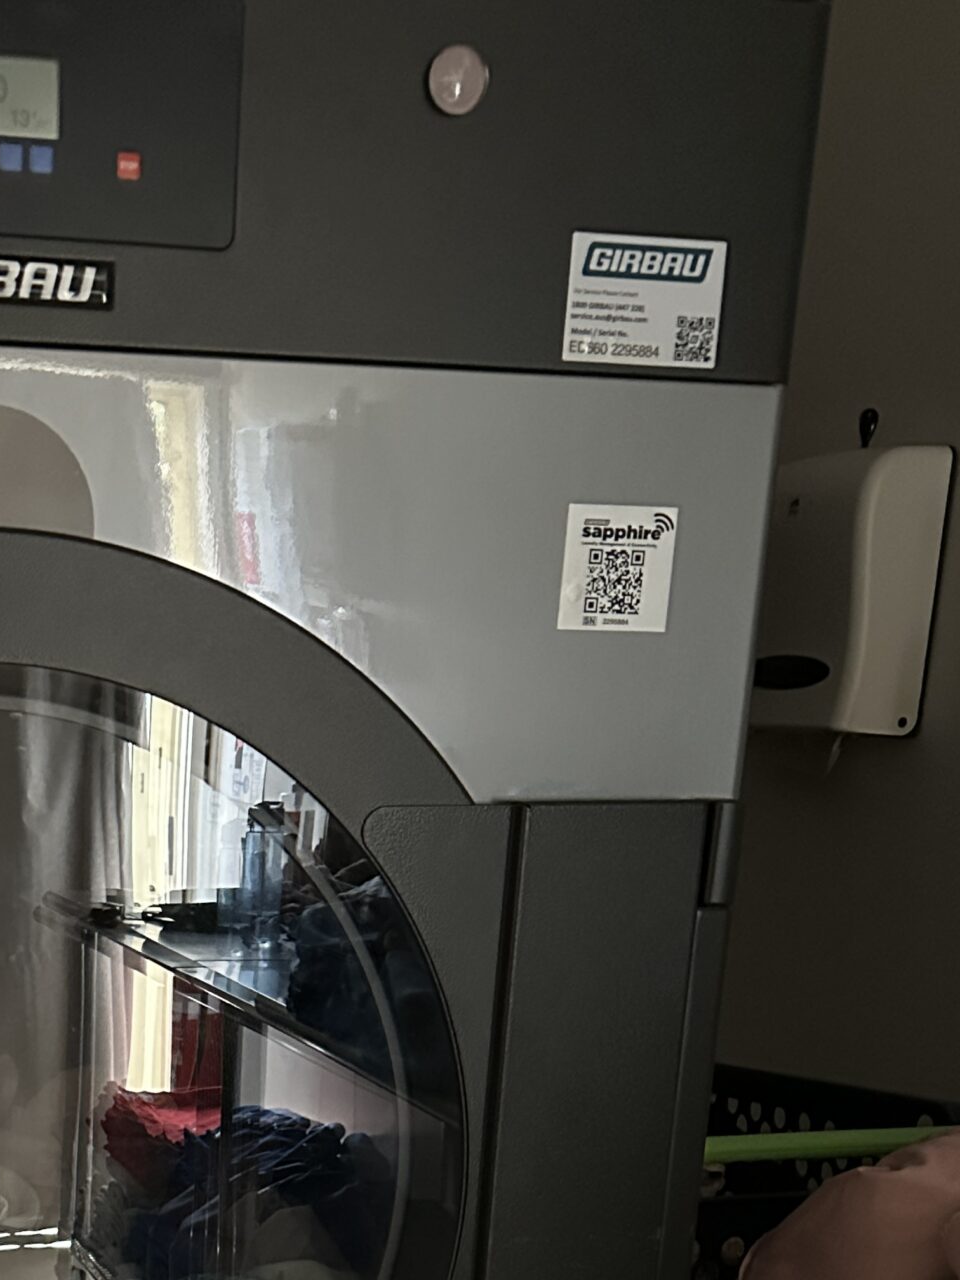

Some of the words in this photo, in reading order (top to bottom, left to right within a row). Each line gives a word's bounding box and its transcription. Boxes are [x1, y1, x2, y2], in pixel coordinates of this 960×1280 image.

[589, 247, 706, 278] GIRBAU
[571, 328, 592, 336] Model
[611, 342, 659, 358] 2295884
[582, 525, 661, 541] sapphire
